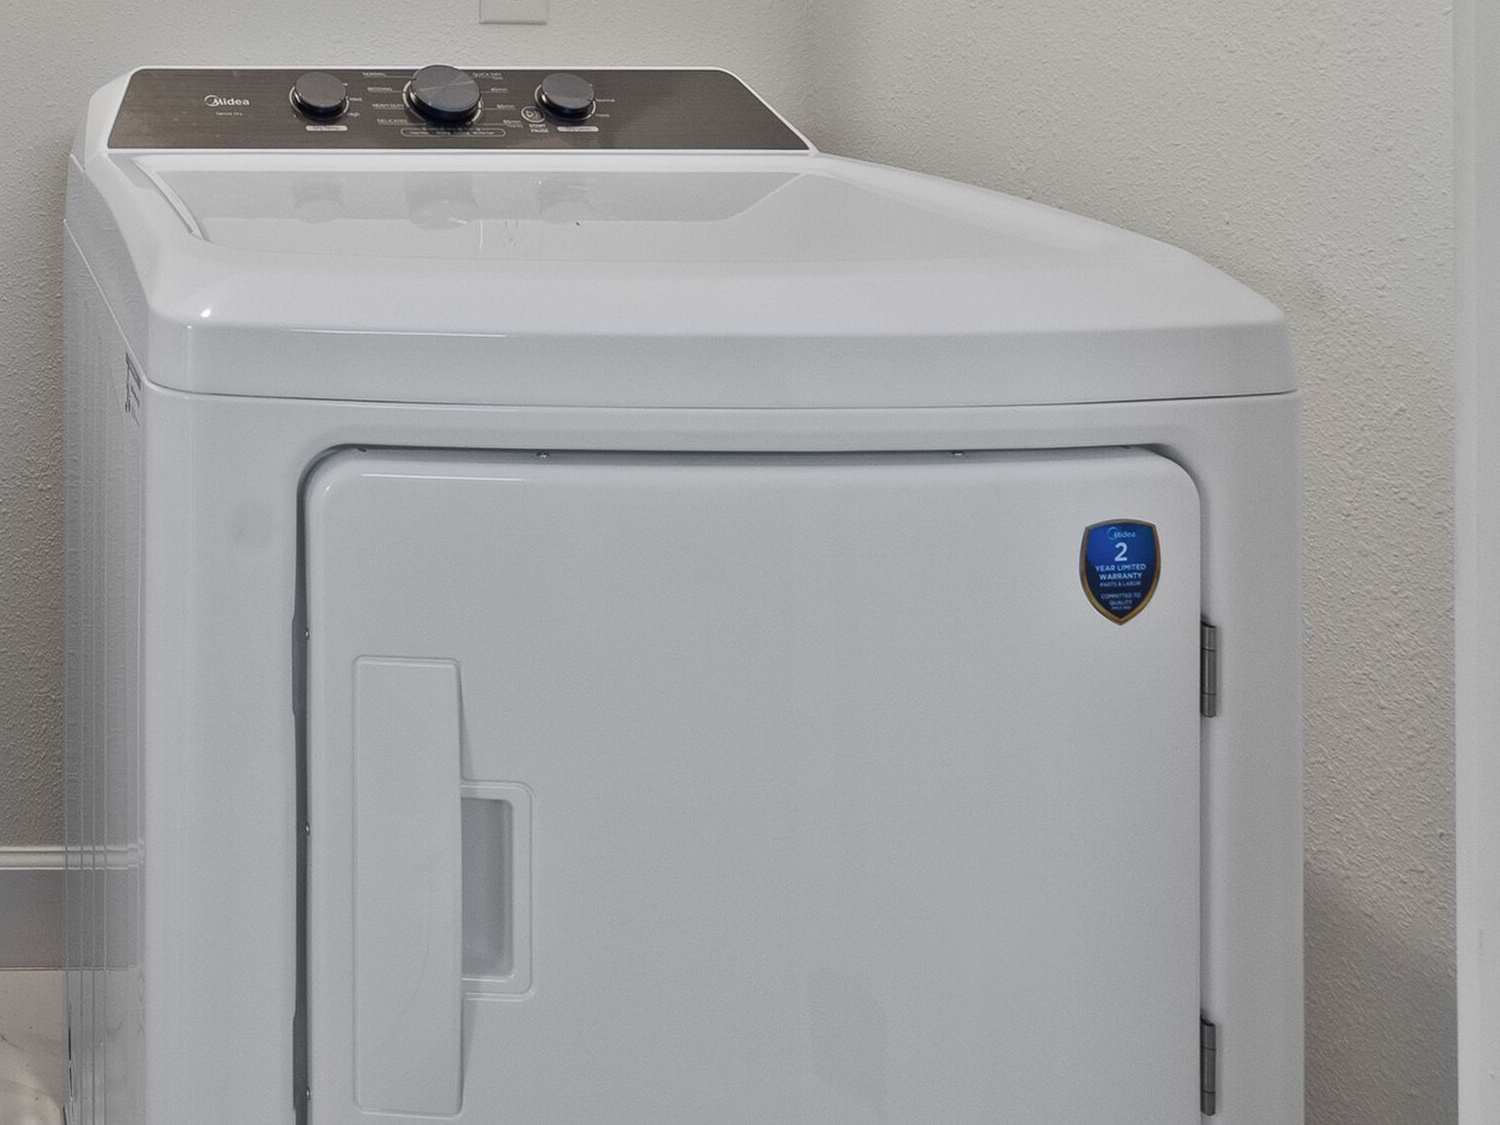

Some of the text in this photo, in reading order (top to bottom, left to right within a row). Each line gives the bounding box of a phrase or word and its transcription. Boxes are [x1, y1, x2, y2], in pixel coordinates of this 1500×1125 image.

[204, 95, 250, 107] Midea
[1107, 527, 1136, 540] Midea
[1114, 542, 1128, 562] 2
[1095, 563, 1146, 572] YEAR LIMITED
[1099, 572, 1142, 580] WARRANTY
